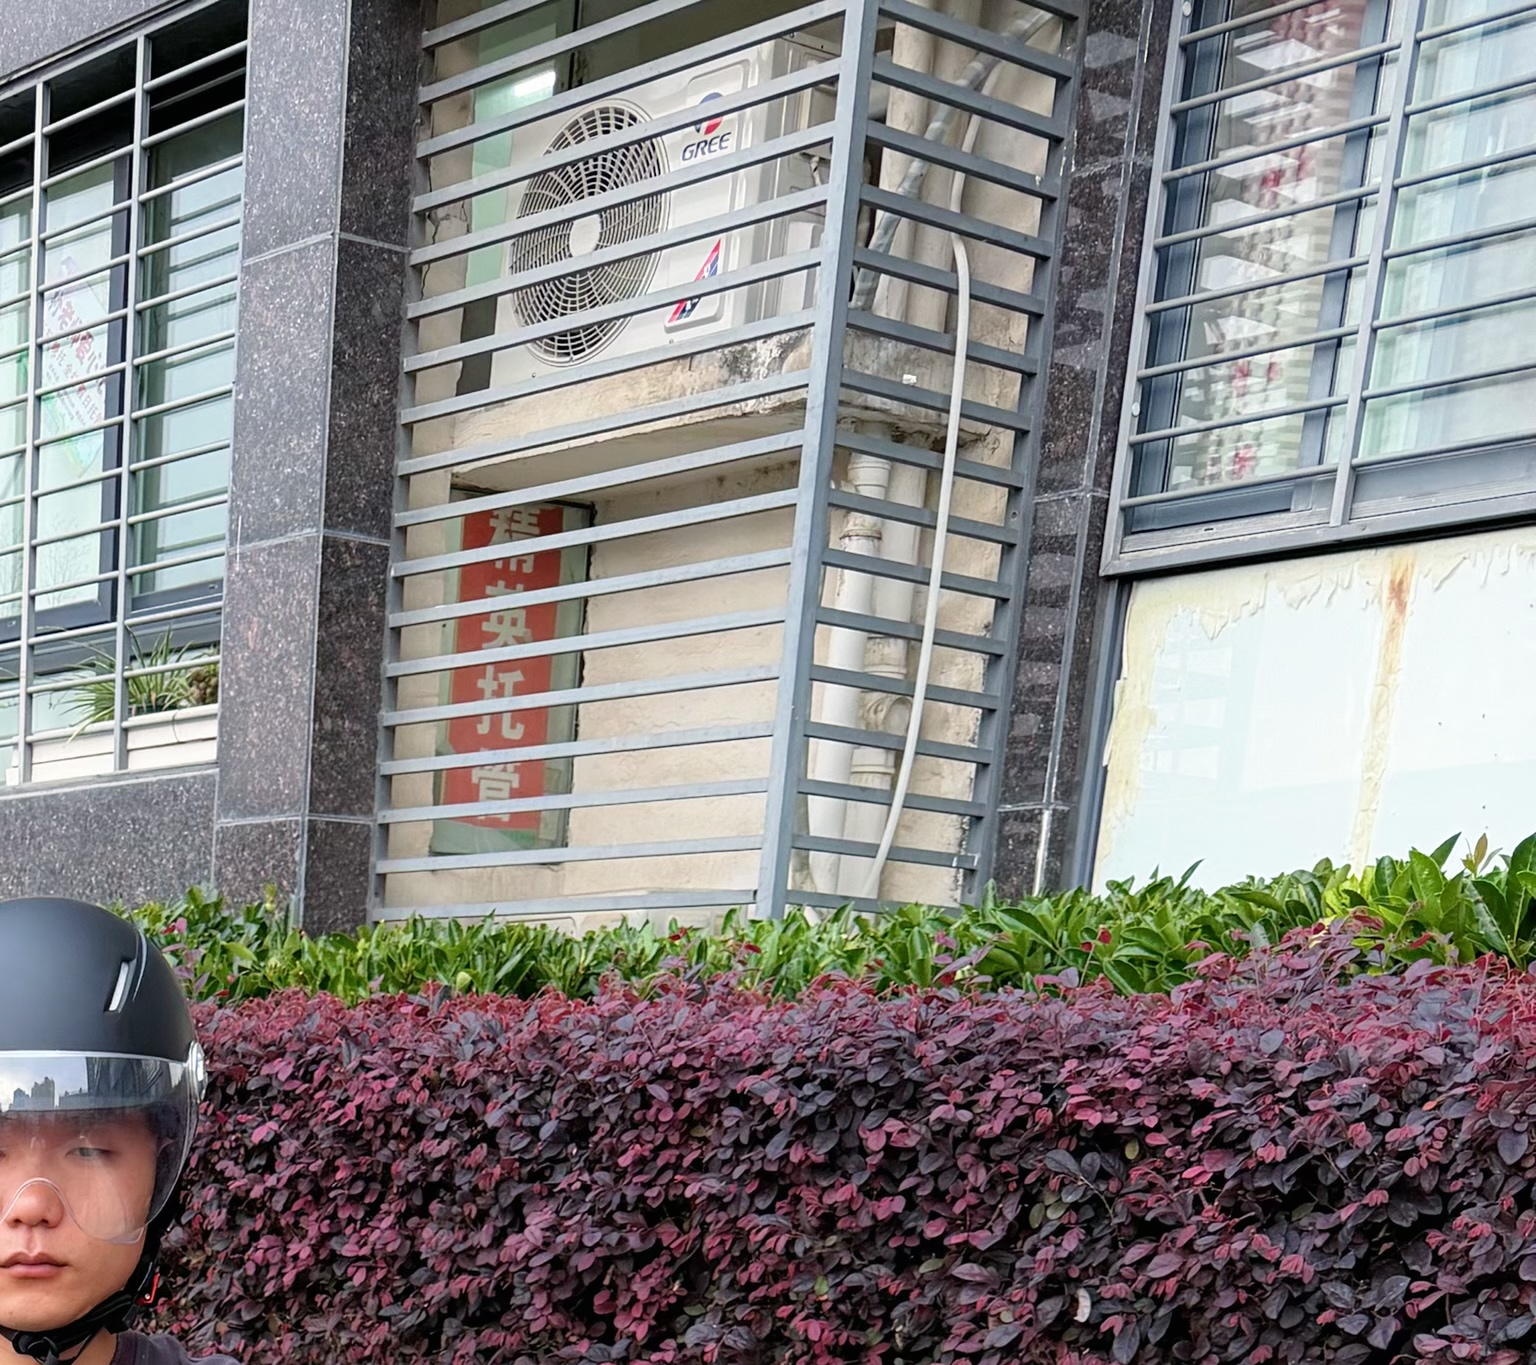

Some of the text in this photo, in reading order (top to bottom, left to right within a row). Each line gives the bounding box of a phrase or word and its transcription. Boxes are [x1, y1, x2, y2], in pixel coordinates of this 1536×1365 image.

[681, 131, 732, 162] GREE
[471, 506, 542, 822] 精英托管
